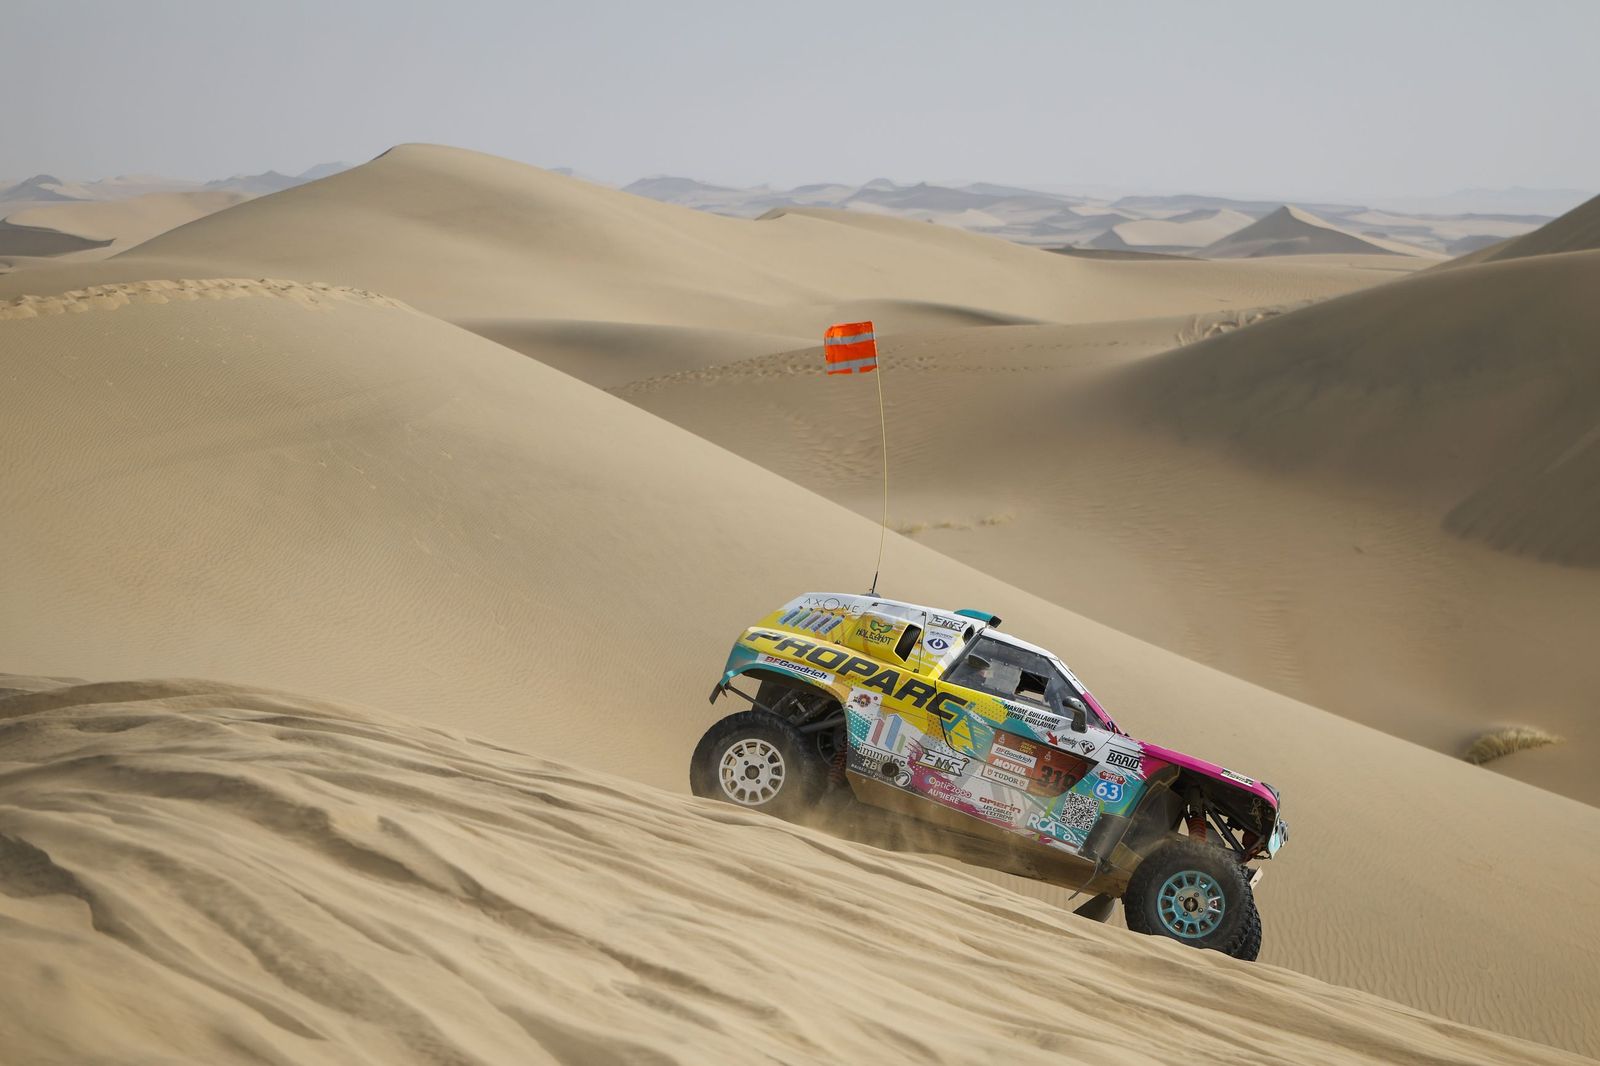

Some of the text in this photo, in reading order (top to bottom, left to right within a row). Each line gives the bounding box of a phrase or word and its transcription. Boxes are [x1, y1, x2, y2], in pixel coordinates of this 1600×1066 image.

[804, 597, 860, 613] AXONE
[765, 656, 828, 679] BFGoodrich
[1003, 703, 1061, 725] MAXIME GUILLAUME
[1025, 716, 1057, 731] GUILLAUME
[995, 747, 1033, 763] BFGoodrich
[1106, 752, 1140, 769] BRAID
[992, 758, 1027, 776] MOTUL
[993, 771, 1020, 785] TUDOR
[1096, 781, 1119, 800] 63
[1026, 812, 1057, 837] RCA
